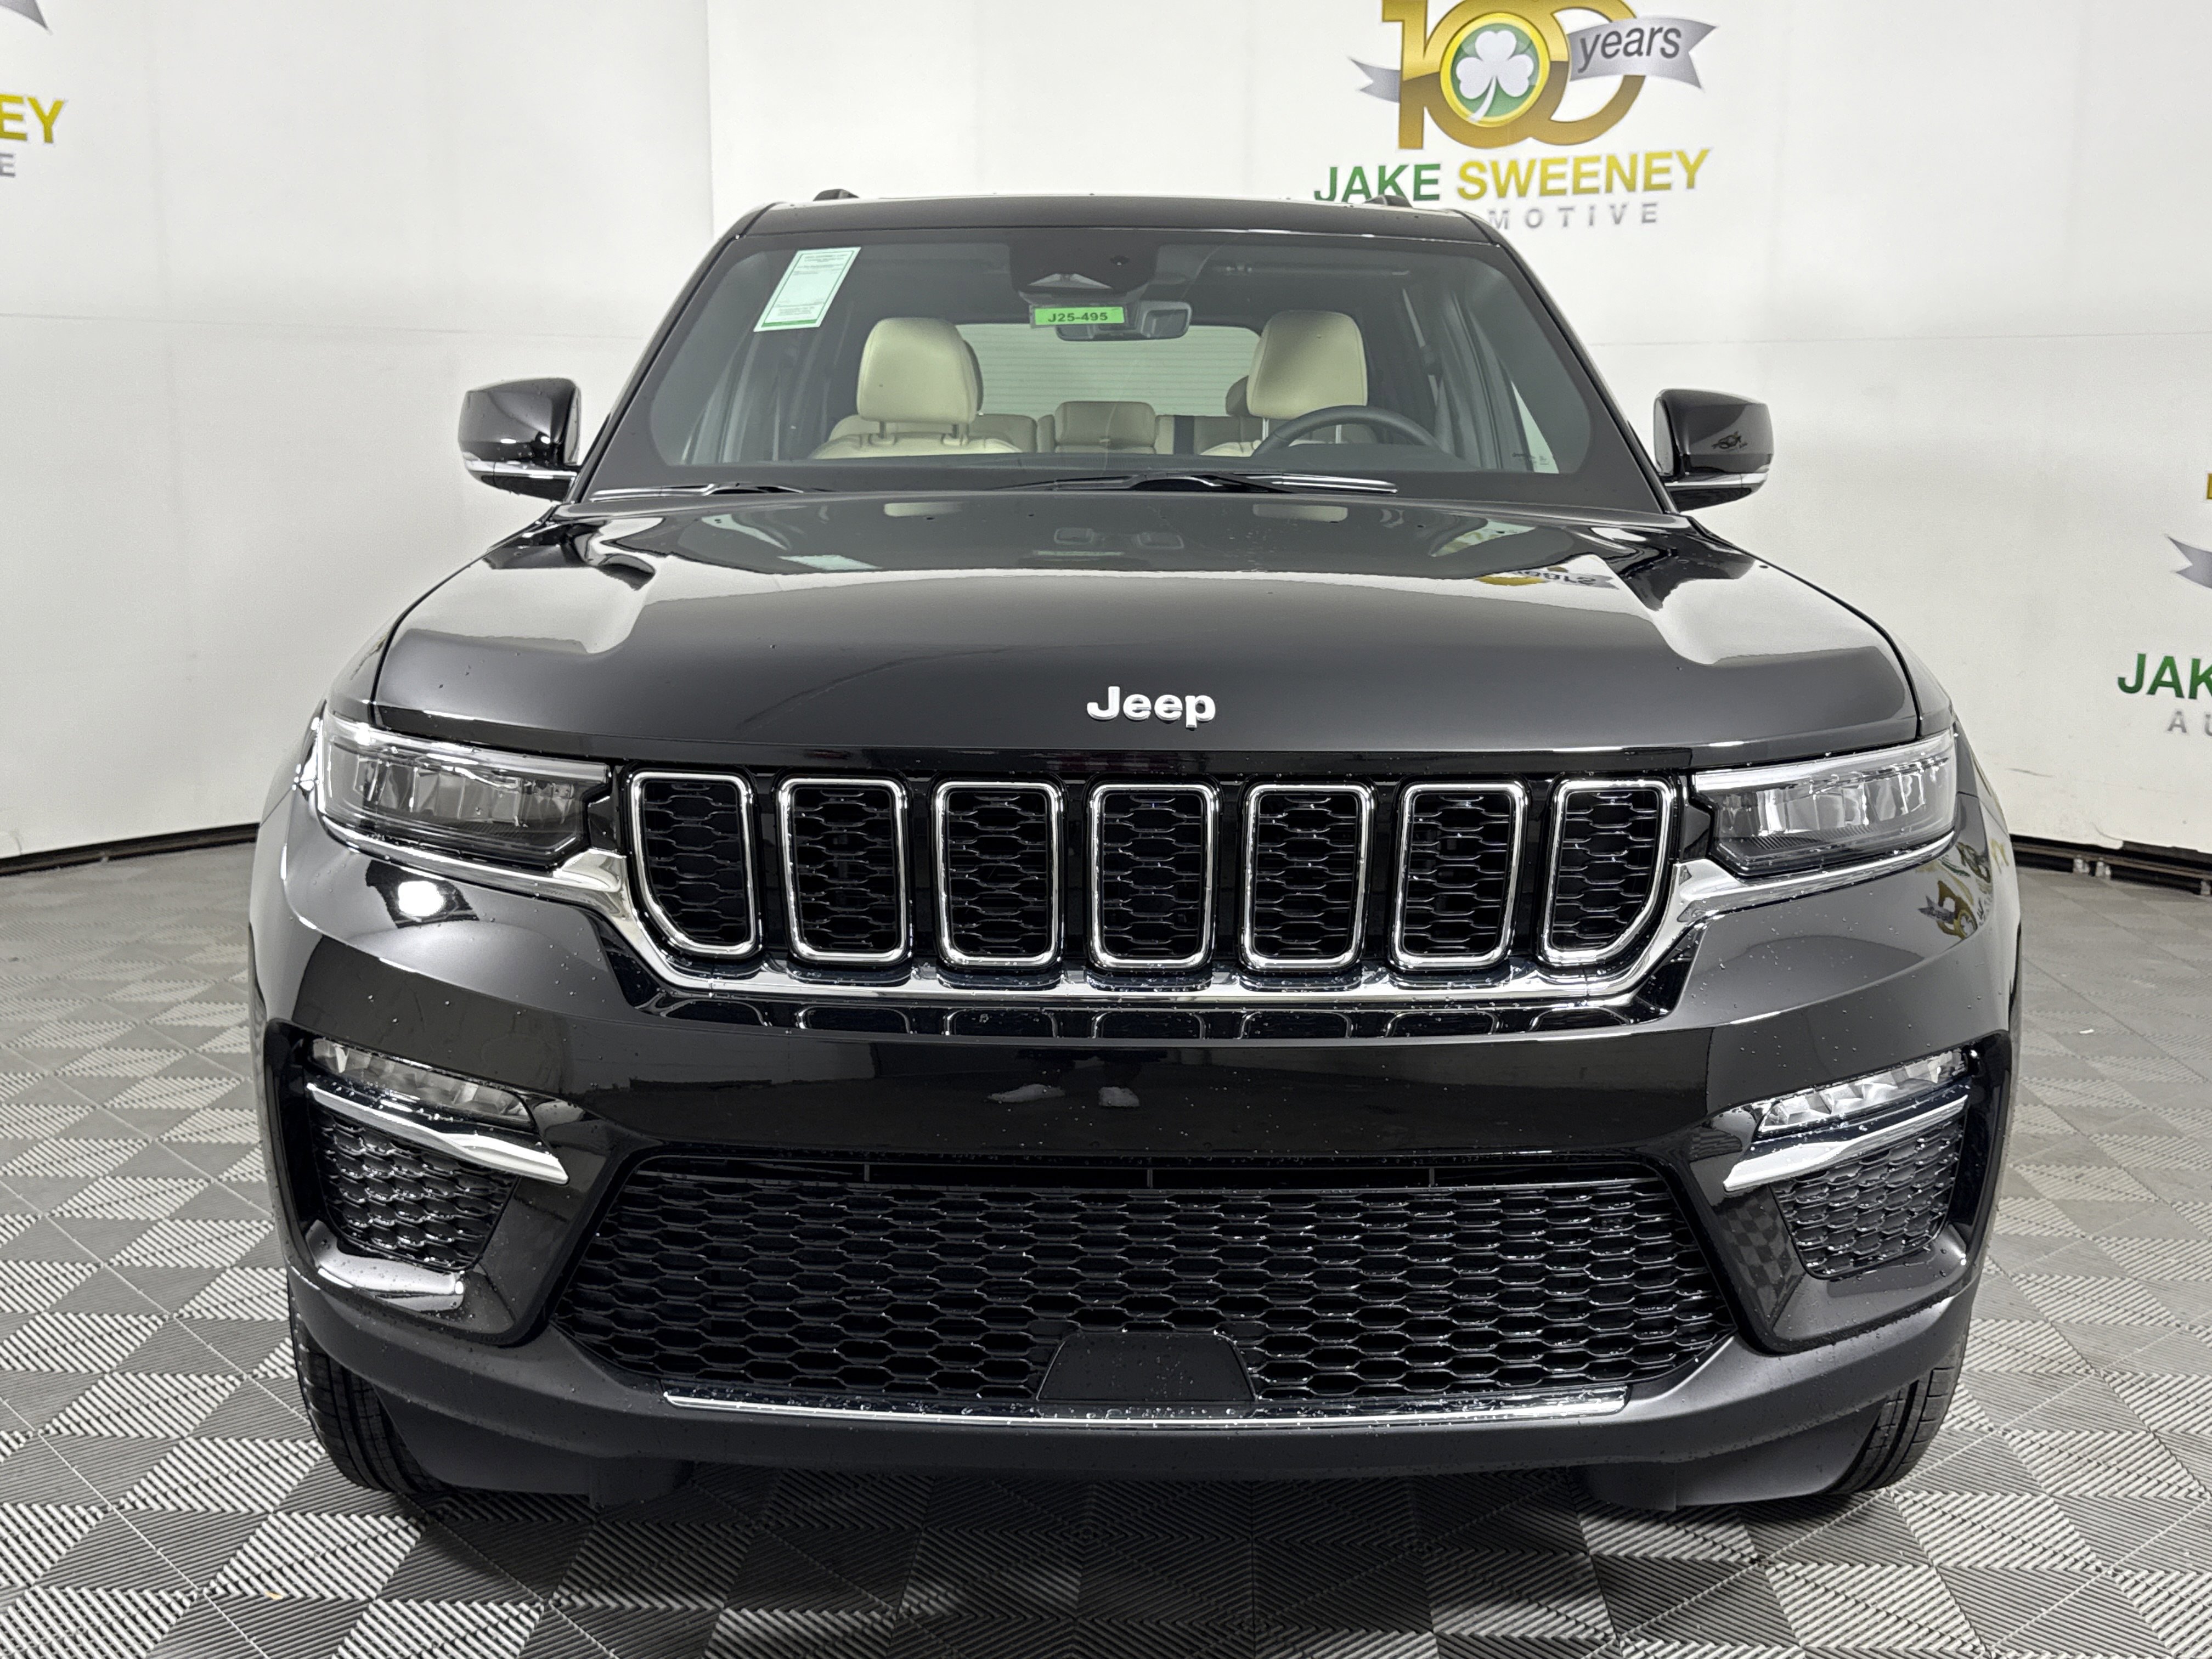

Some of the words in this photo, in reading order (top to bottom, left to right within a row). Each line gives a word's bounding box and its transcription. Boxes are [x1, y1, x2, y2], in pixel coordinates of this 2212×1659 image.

[1577, 26, 1682, 74] years
[1314, 163, 1441, 203] JAKE
[1457, 149, 1710, 201] SWEENEY
[1048, 312, 1108, 323] J25-495
[2118, 653, 2212, 700] JAK
[1086, 685, 1216, 729] Jeep
